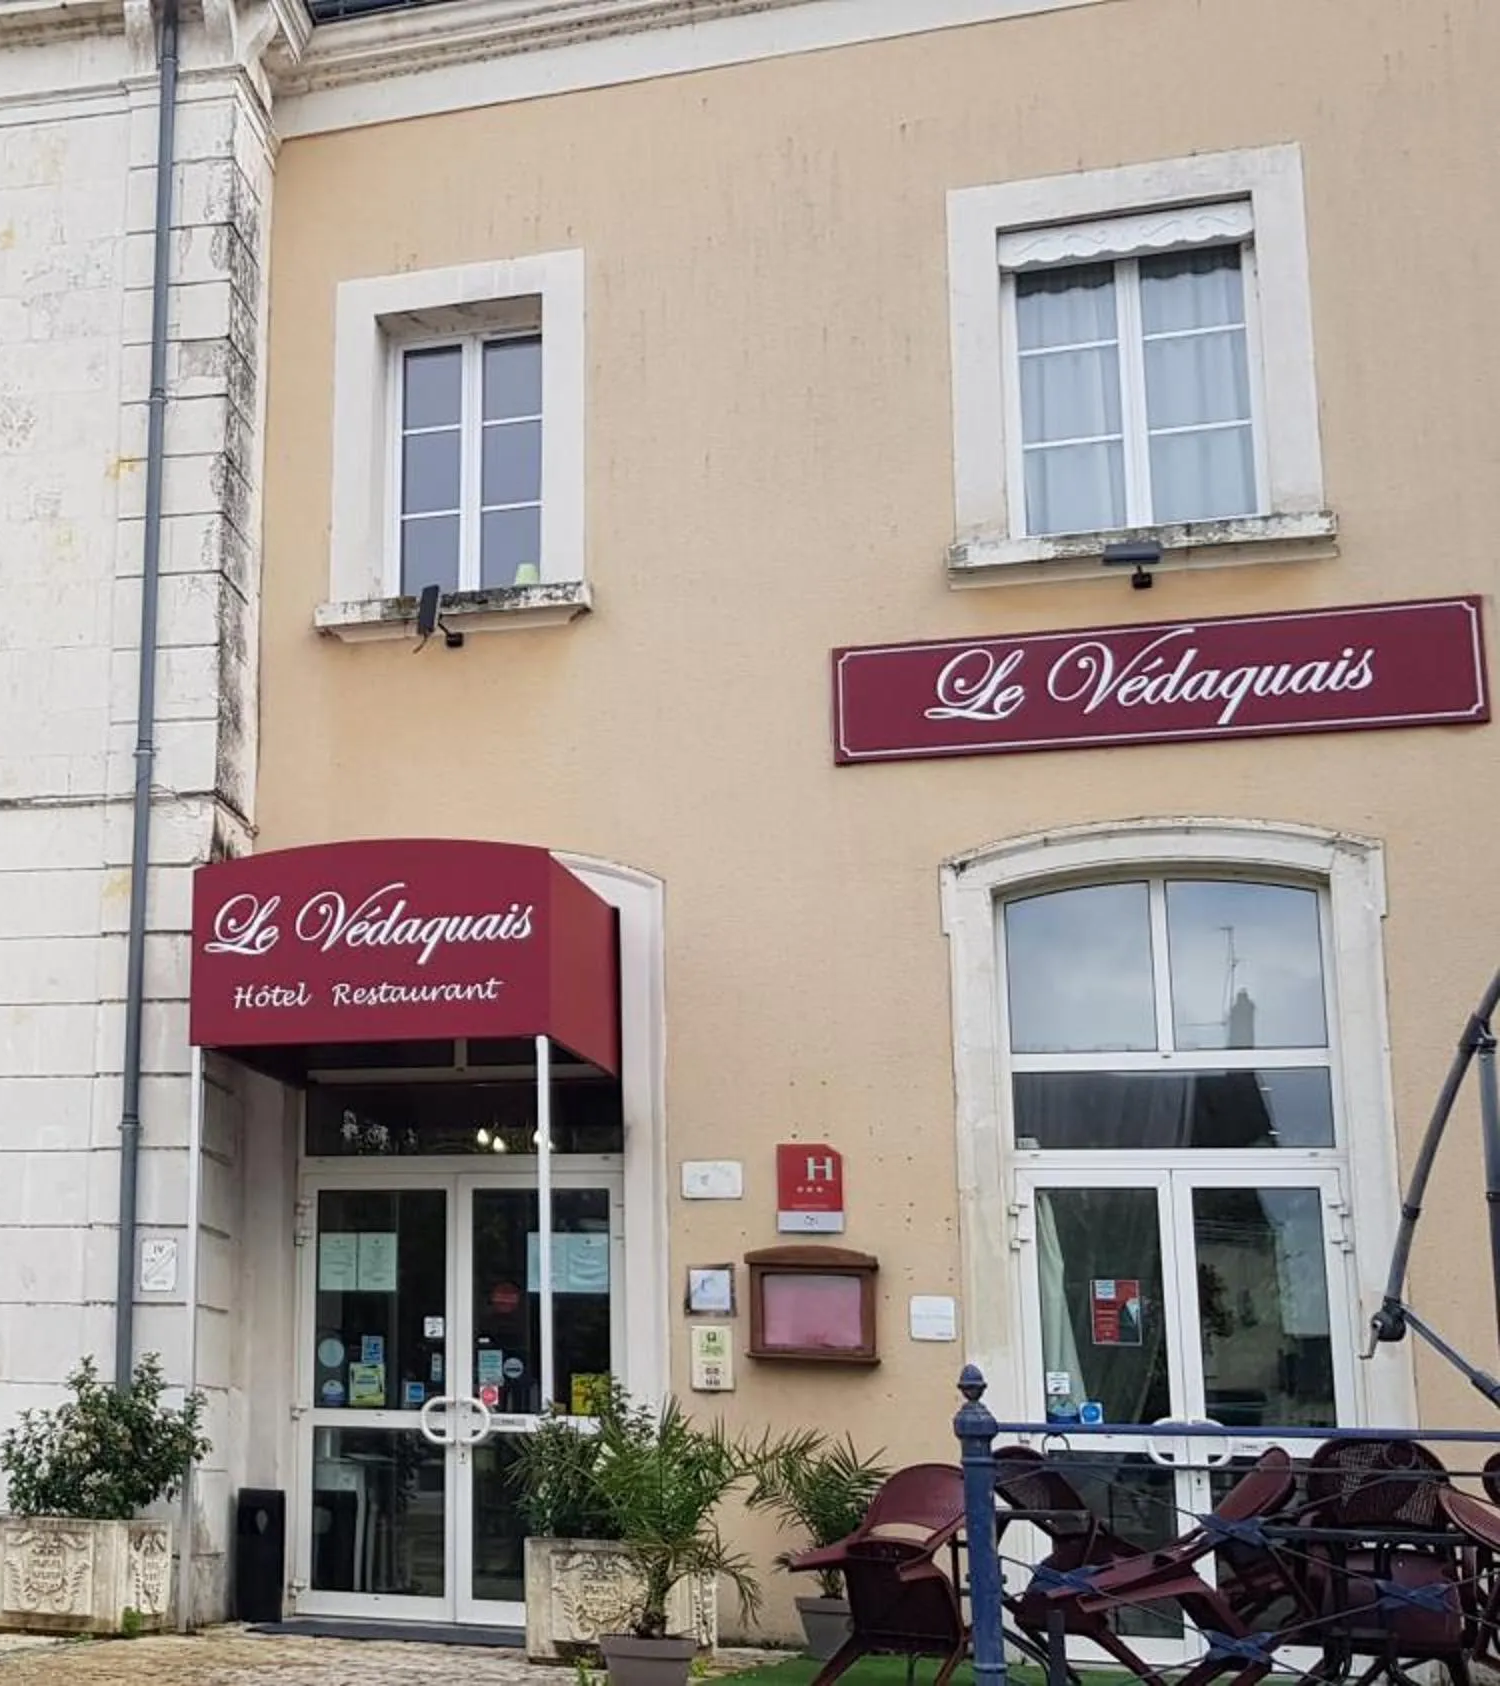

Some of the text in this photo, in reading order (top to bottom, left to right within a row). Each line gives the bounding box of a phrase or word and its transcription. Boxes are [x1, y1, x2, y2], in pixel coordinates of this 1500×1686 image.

[924, 627, 1376, 725] Le Védaquais
[204, 882, 534, 966] Le Védaquais
[233, 976, 505, 1009] Hôtel Restaurant
[807, 1156, 833, 1181] H
